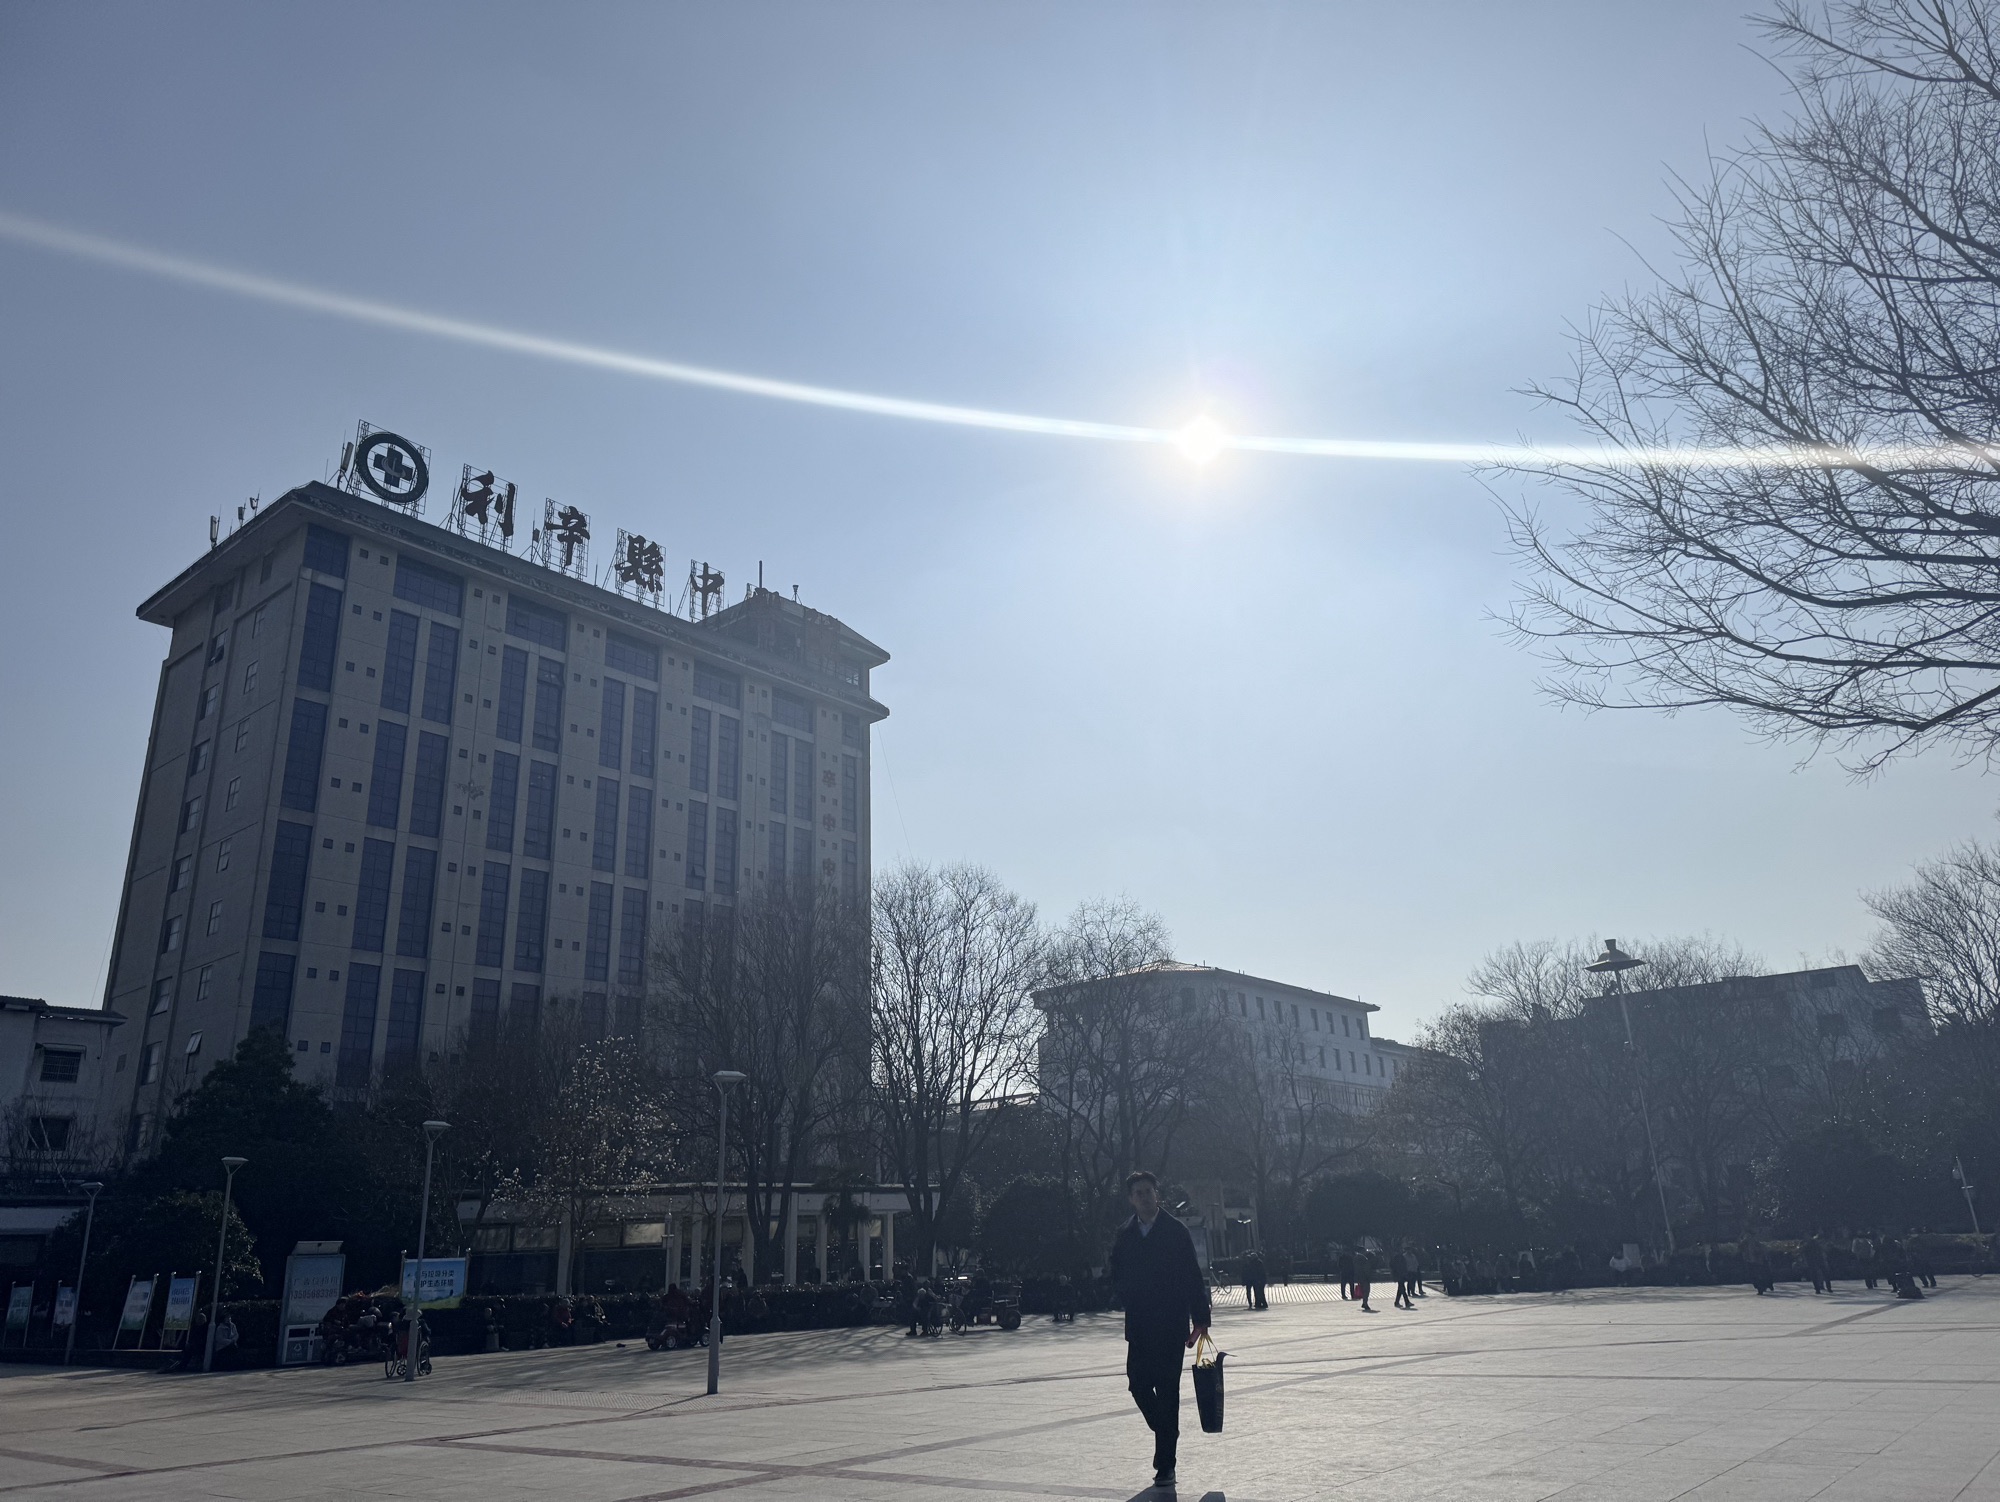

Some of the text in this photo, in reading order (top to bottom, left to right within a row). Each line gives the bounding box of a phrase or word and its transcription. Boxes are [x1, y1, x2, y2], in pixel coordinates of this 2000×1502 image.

[414, 1270, 455, 1278] 与垃圾分类
